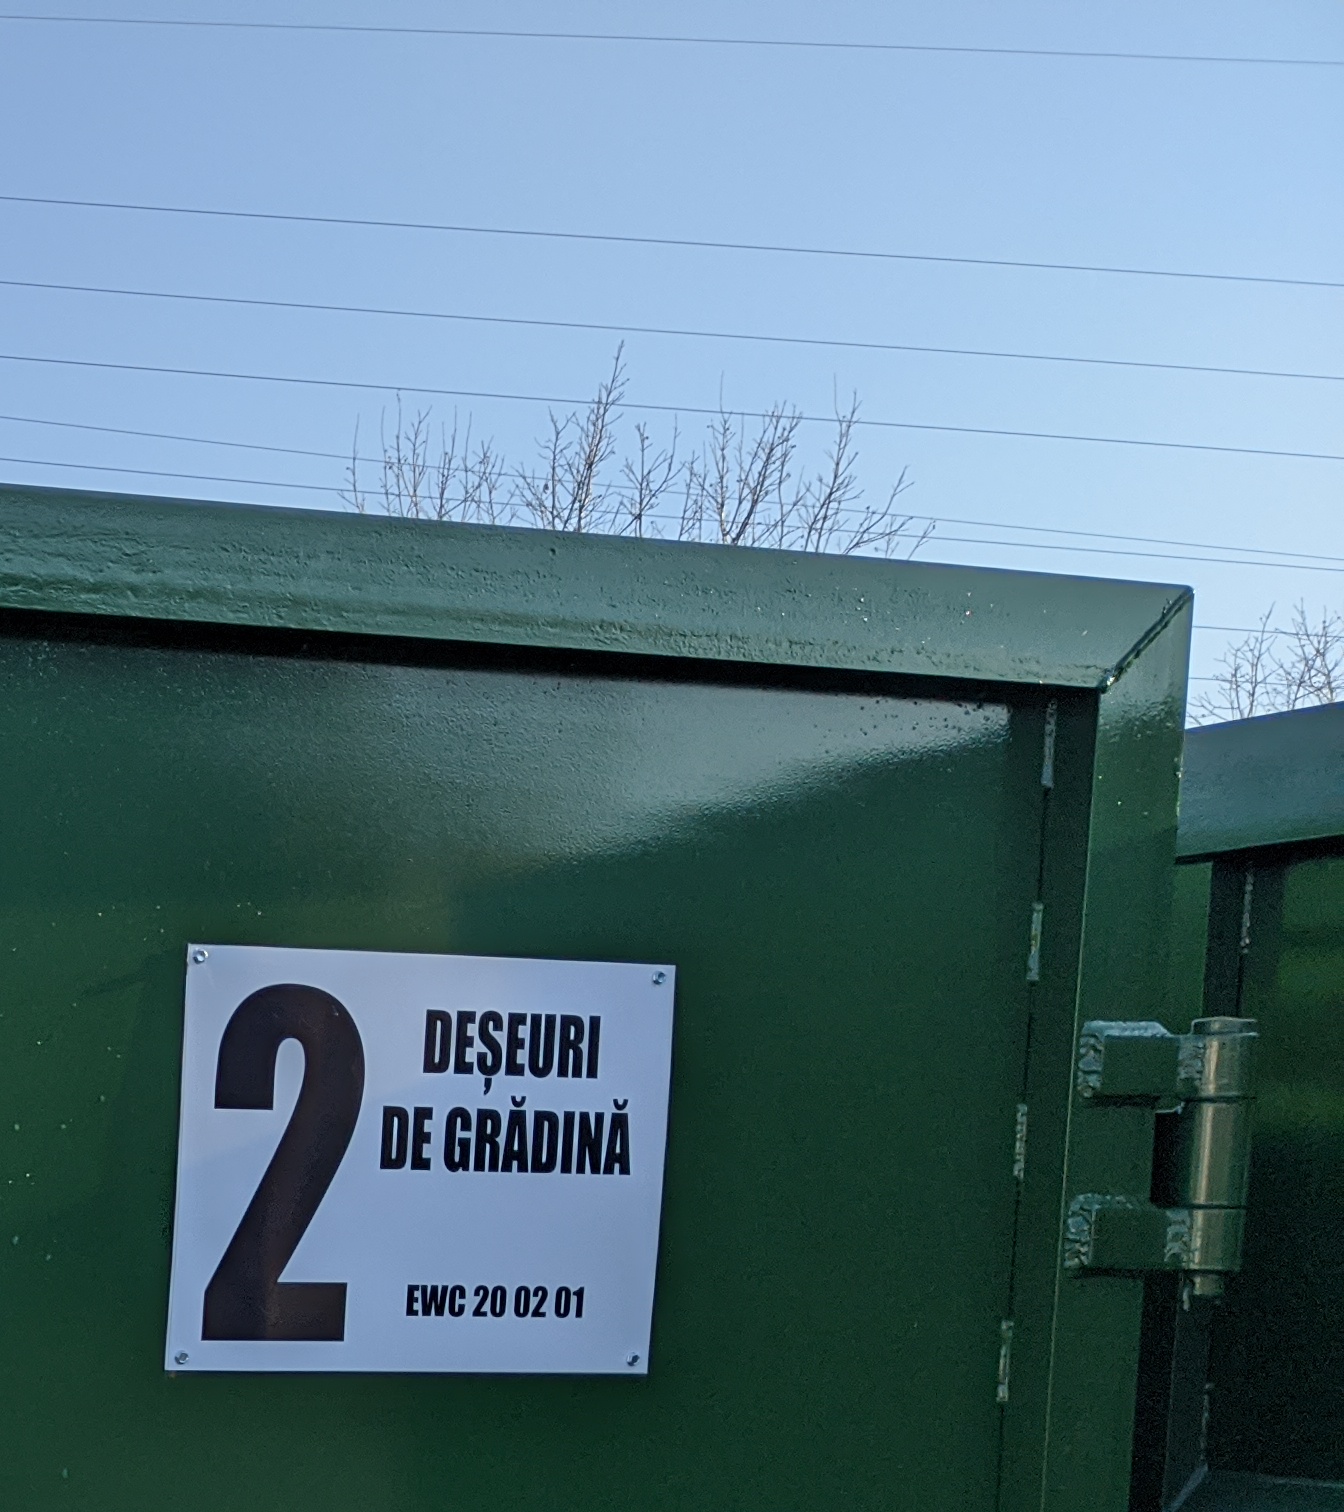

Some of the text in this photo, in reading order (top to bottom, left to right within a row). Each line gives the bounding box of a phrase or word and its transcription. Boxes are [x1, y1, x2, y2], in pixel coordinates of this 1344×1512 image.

[422, 1008, 602, 1094] DEȘEURI
[201, 983, 365, 1342] 2
[379, 1094, 631, 1176] DE GRĂDINĂ
[405, 1284, 585, 1319] EWC 20 02 01
